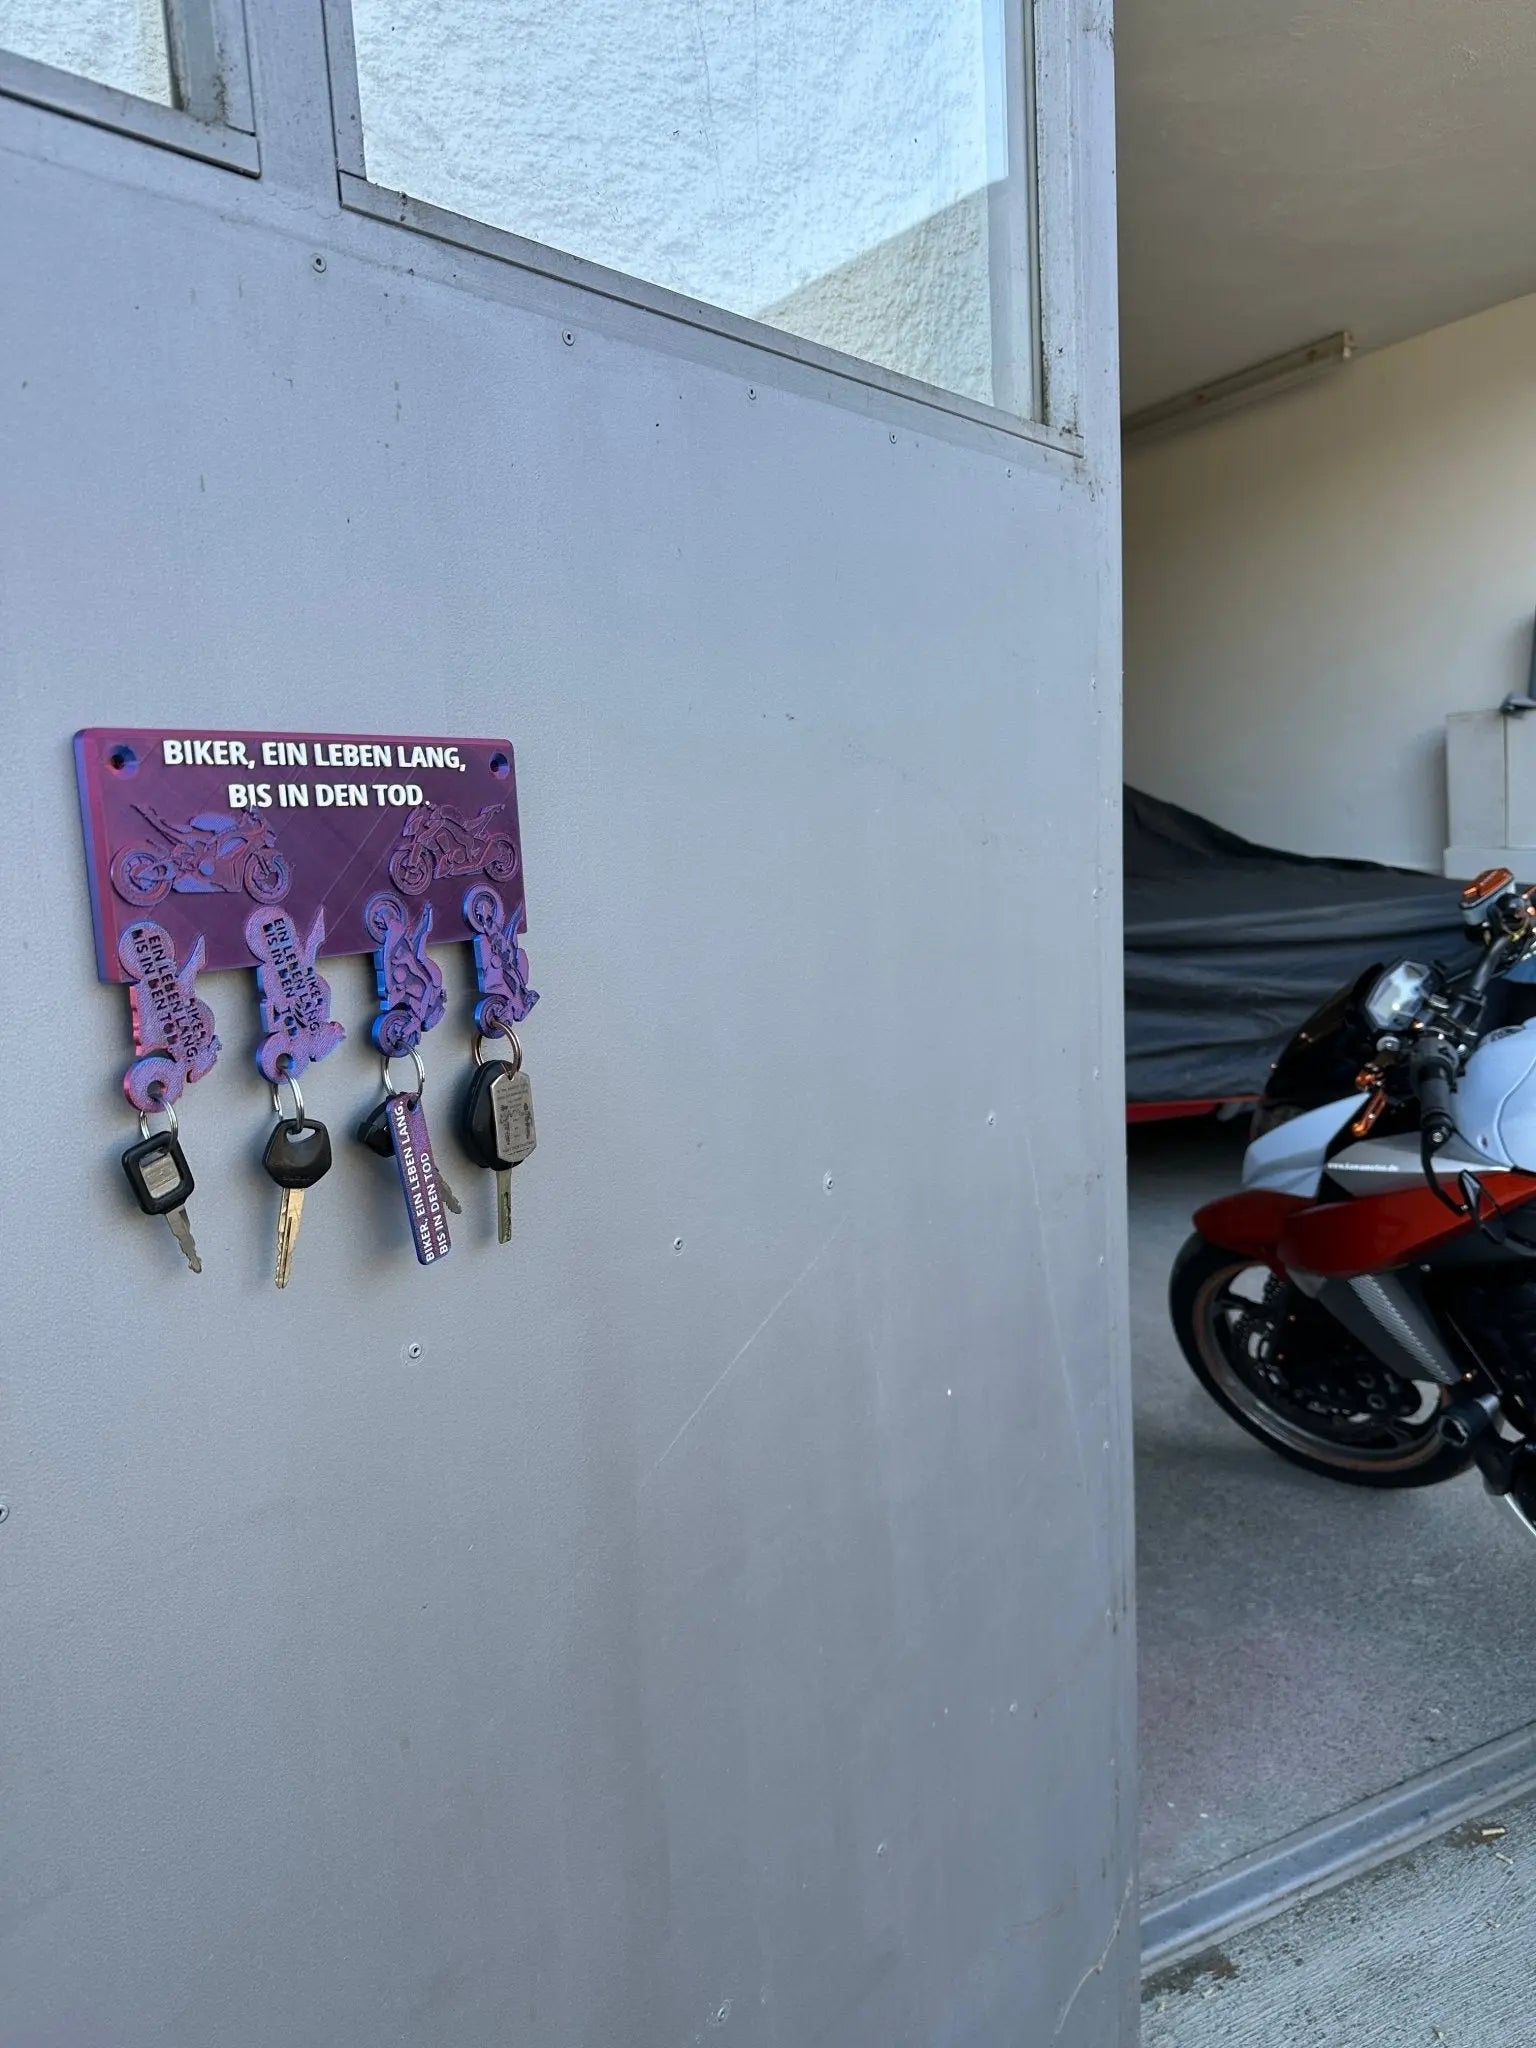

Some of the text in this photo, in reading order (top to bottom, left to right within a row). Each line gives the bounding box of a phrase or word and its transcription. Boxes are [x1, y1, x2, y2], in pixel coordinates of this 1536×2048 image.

[163, 740, 466, 772] BIKER, EIN LEBEN LANG,
[228, 783, 431, 808] BIS IN DEN TOD.
[140, 957, 155, 975] IN
[271, 949, 285, 966] IN
[274, 918, 289, 943] EIN
[282, 945, 306, 991] LEBEN
[148, 935, 166, 961] EIN
[158, 965, 183, 1014] LEBEN
[403, 1148, 420, 1191] LEBEN
[414, 1193, 426, 1218] EIN
[420, 1152, 449, 1255] BIS IN DEN TOD
